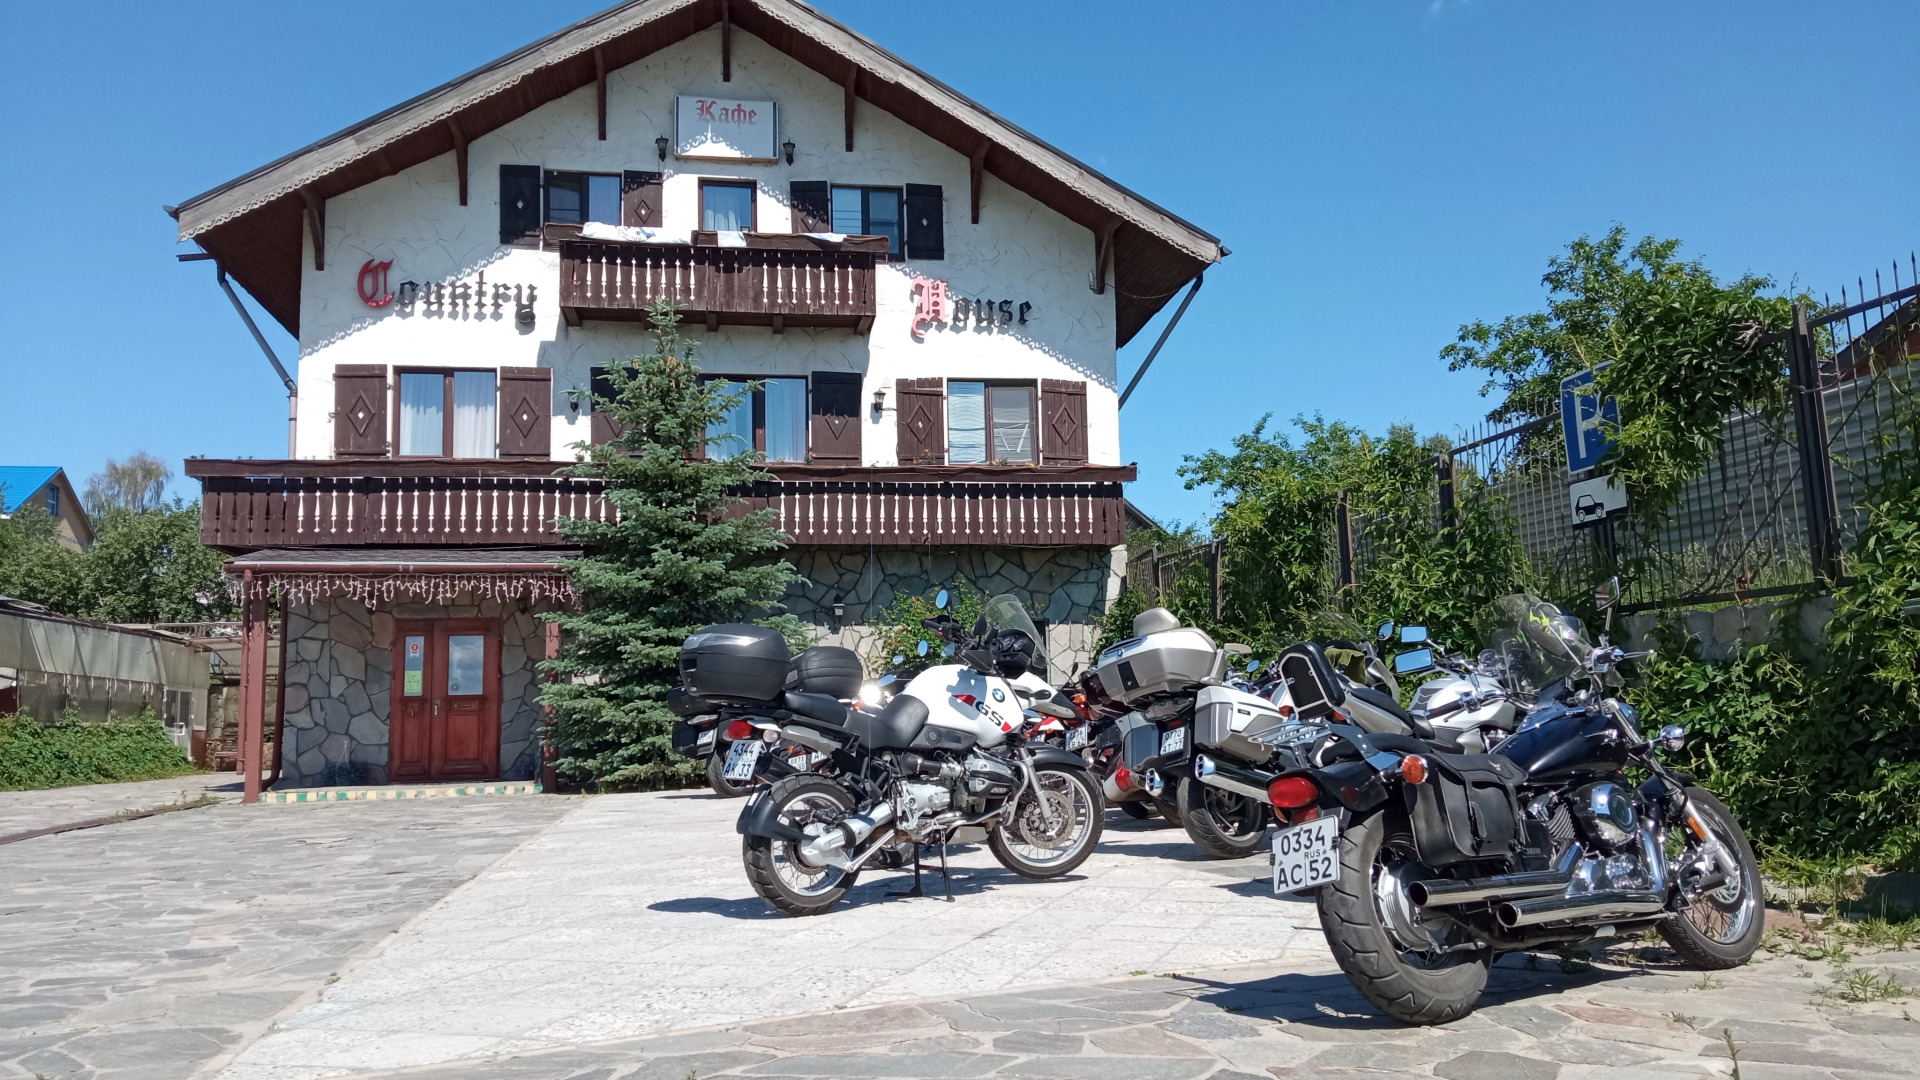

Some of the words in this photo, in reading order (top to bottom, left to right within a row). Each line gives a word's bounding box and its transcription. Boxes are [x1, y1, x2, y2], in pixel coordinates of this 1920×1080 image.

[696, 99, 757, 125] Кафе
[357, 258, 538, 325] Country
[911, 278, 1032, 335] House
[1574, 383, 1606, 459] P
[975, 701, 1004, 727] GS
[733, 742, 755, 757] 4344
[739, 763, 751, 777] 33
[1281, 826, 1326, 856] 0334
[1304, 849, 1321, 860] RUS
[1277, 863, 1303, 890] AC
[1309, 857, 1332, 881] 52
